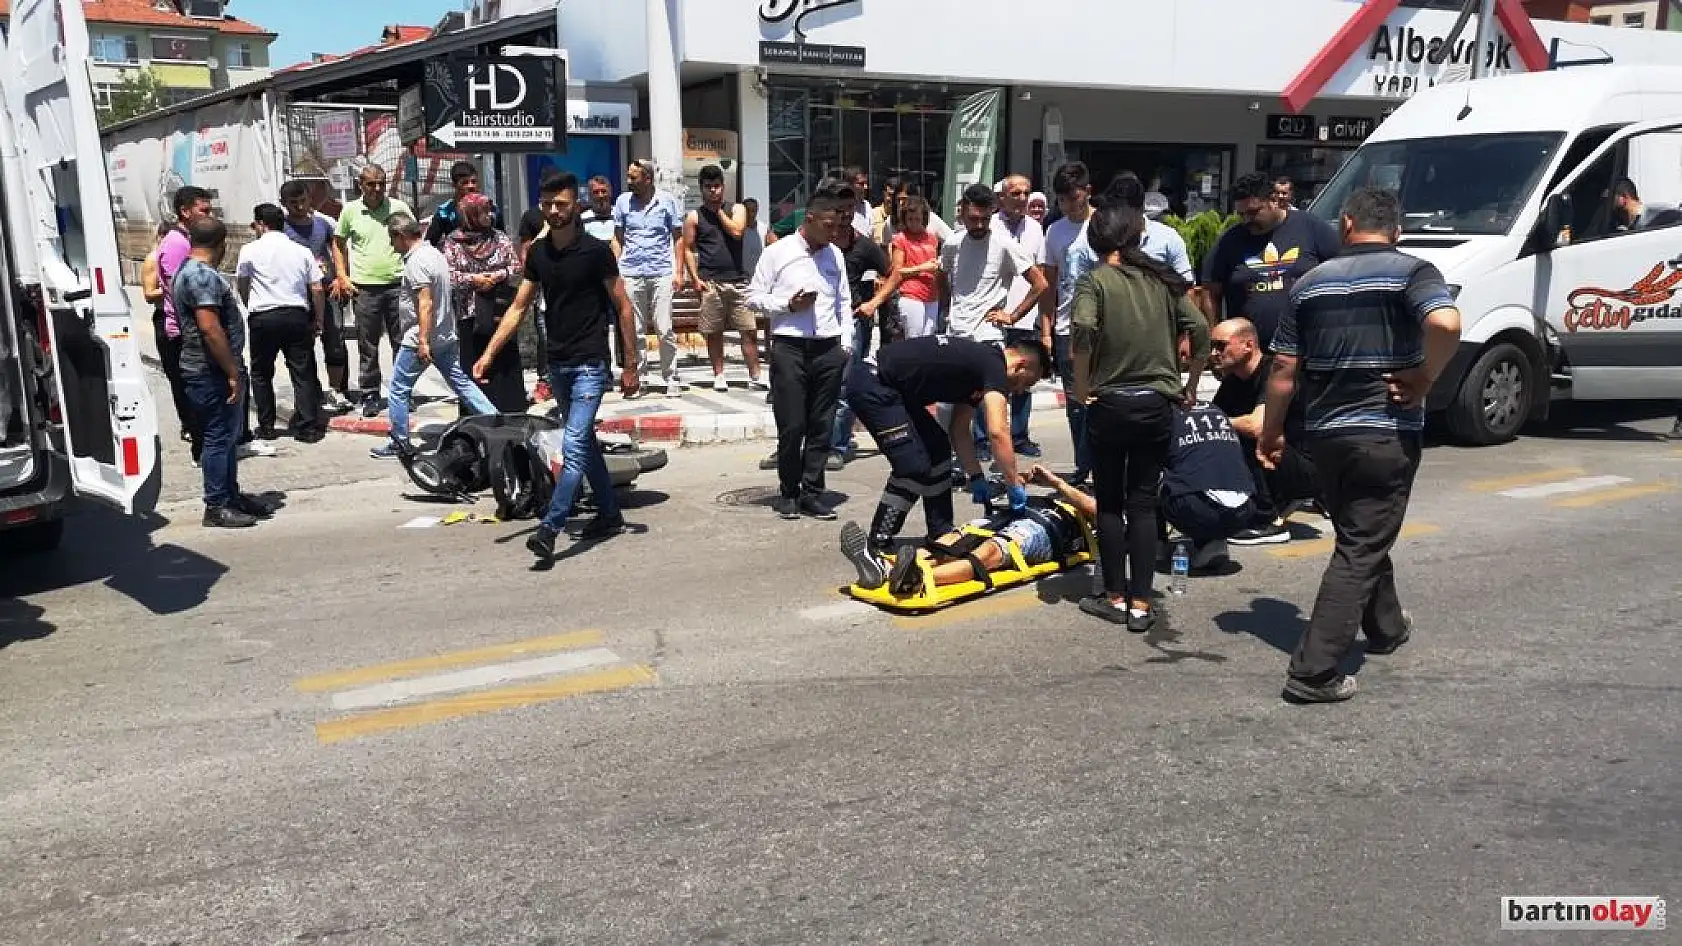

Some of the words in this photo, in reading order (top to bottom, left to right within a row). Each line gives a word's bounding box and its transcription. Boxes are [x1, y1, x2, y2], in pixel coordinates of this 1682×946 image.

[1374, 74, 1419, 93] YAPI
[462, 110, 535, 126] hairstudio
[686, 134, 727, 151] Garanti
[1185, 414, 1231, 431] 112
